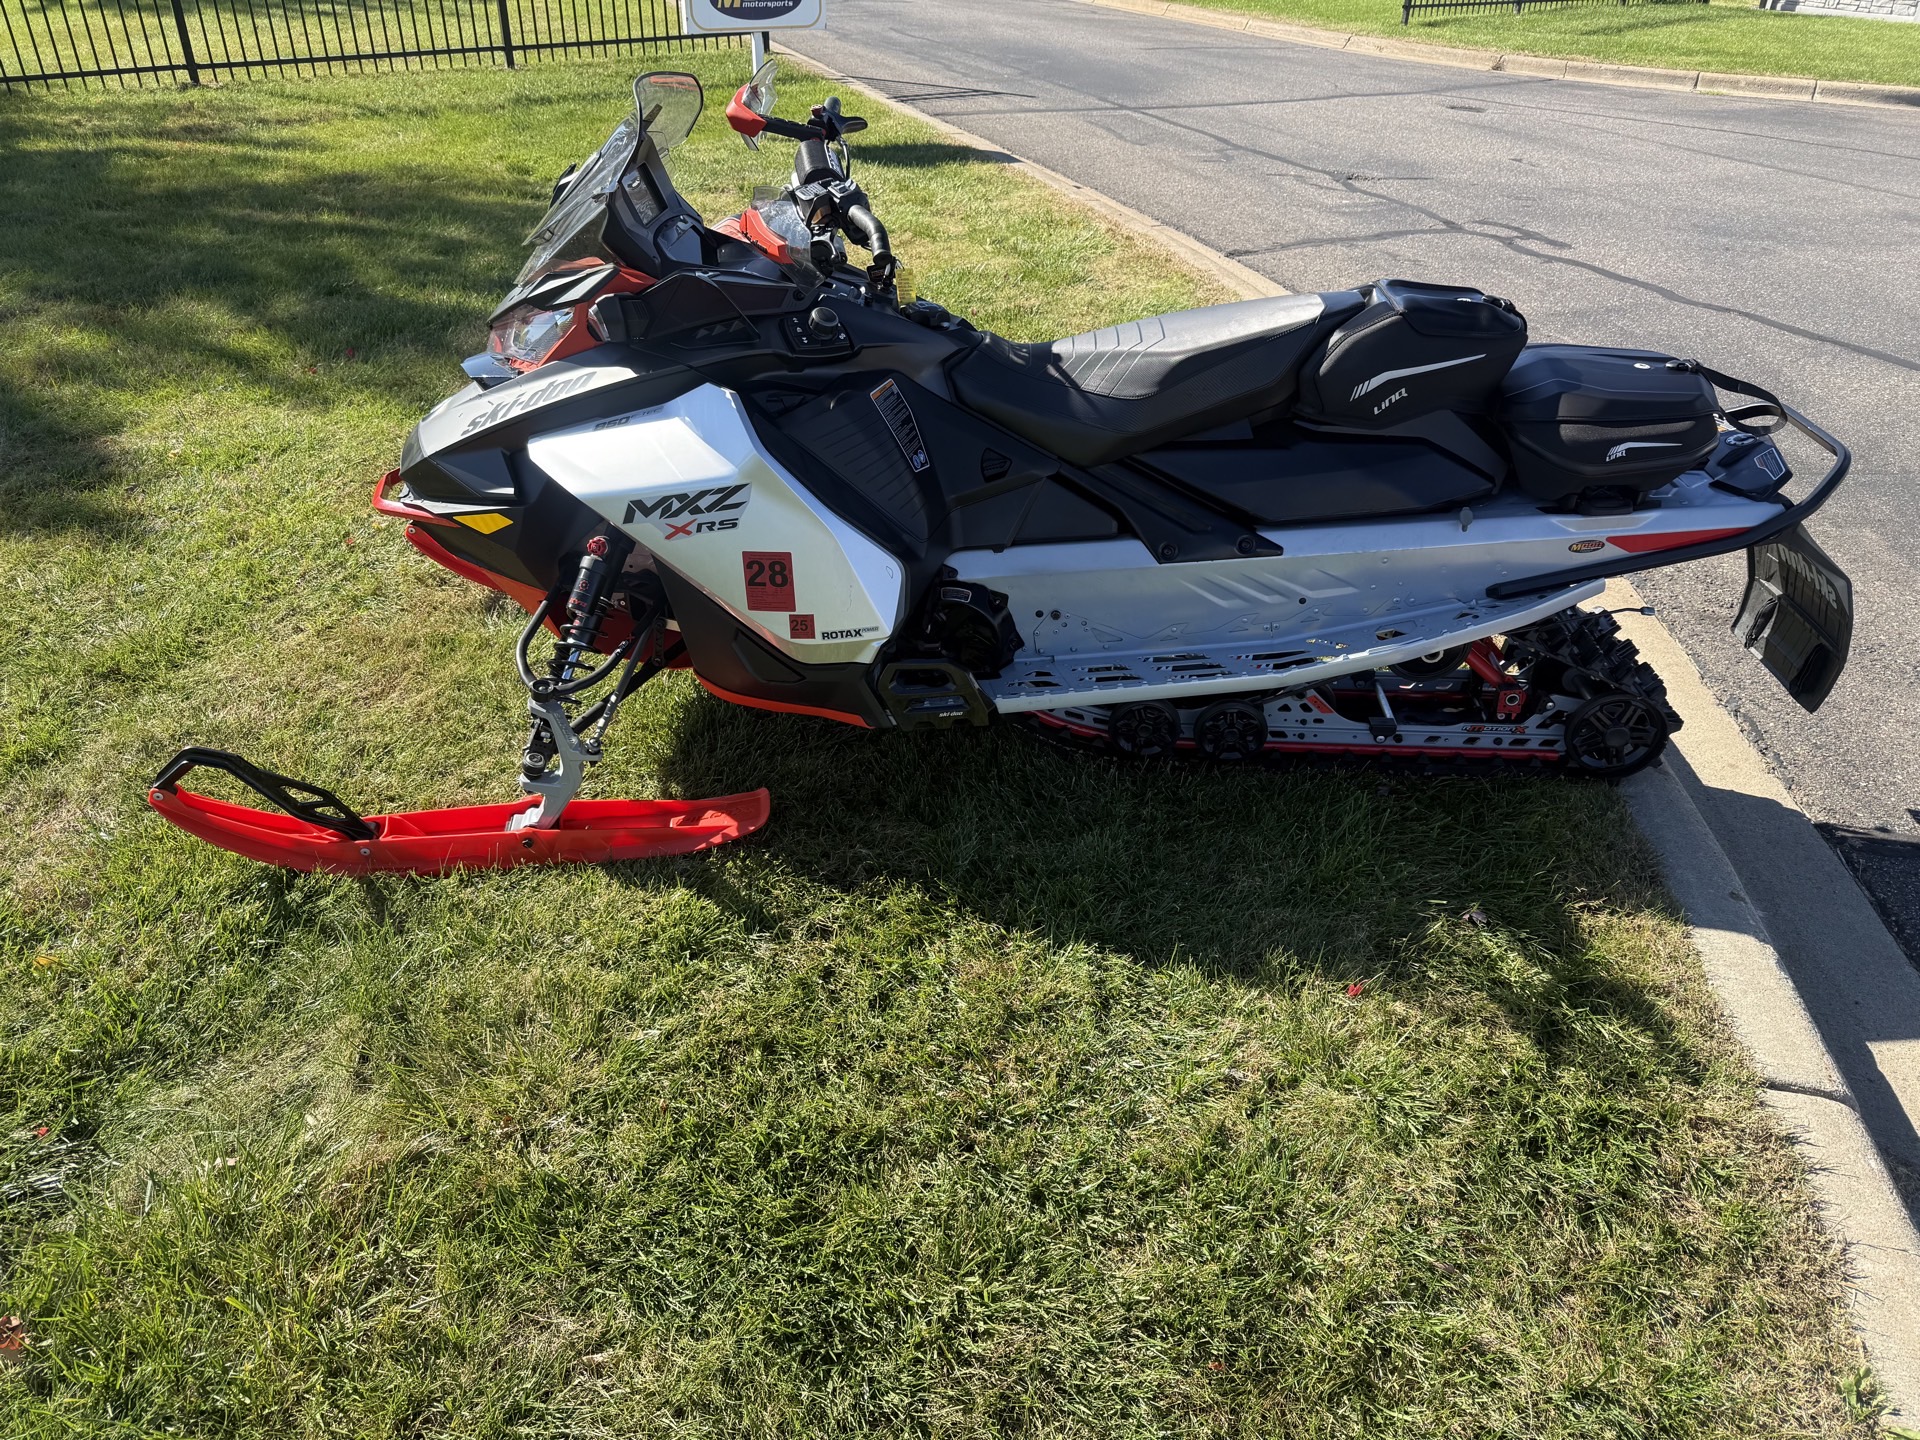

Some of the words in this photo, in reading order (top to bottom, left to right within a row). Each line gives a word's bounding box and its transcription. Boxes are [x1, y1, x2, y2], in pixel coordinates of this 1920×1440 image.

[742, 0, 793, 8] motorsports
[594, 416, 630, 431] 850
[623, 482, 749, 525] MXZ
[746, 560, 789, 588] 28
[790, 619, 809, 632] 25
[821, 628, 863, 640] ROTAX
